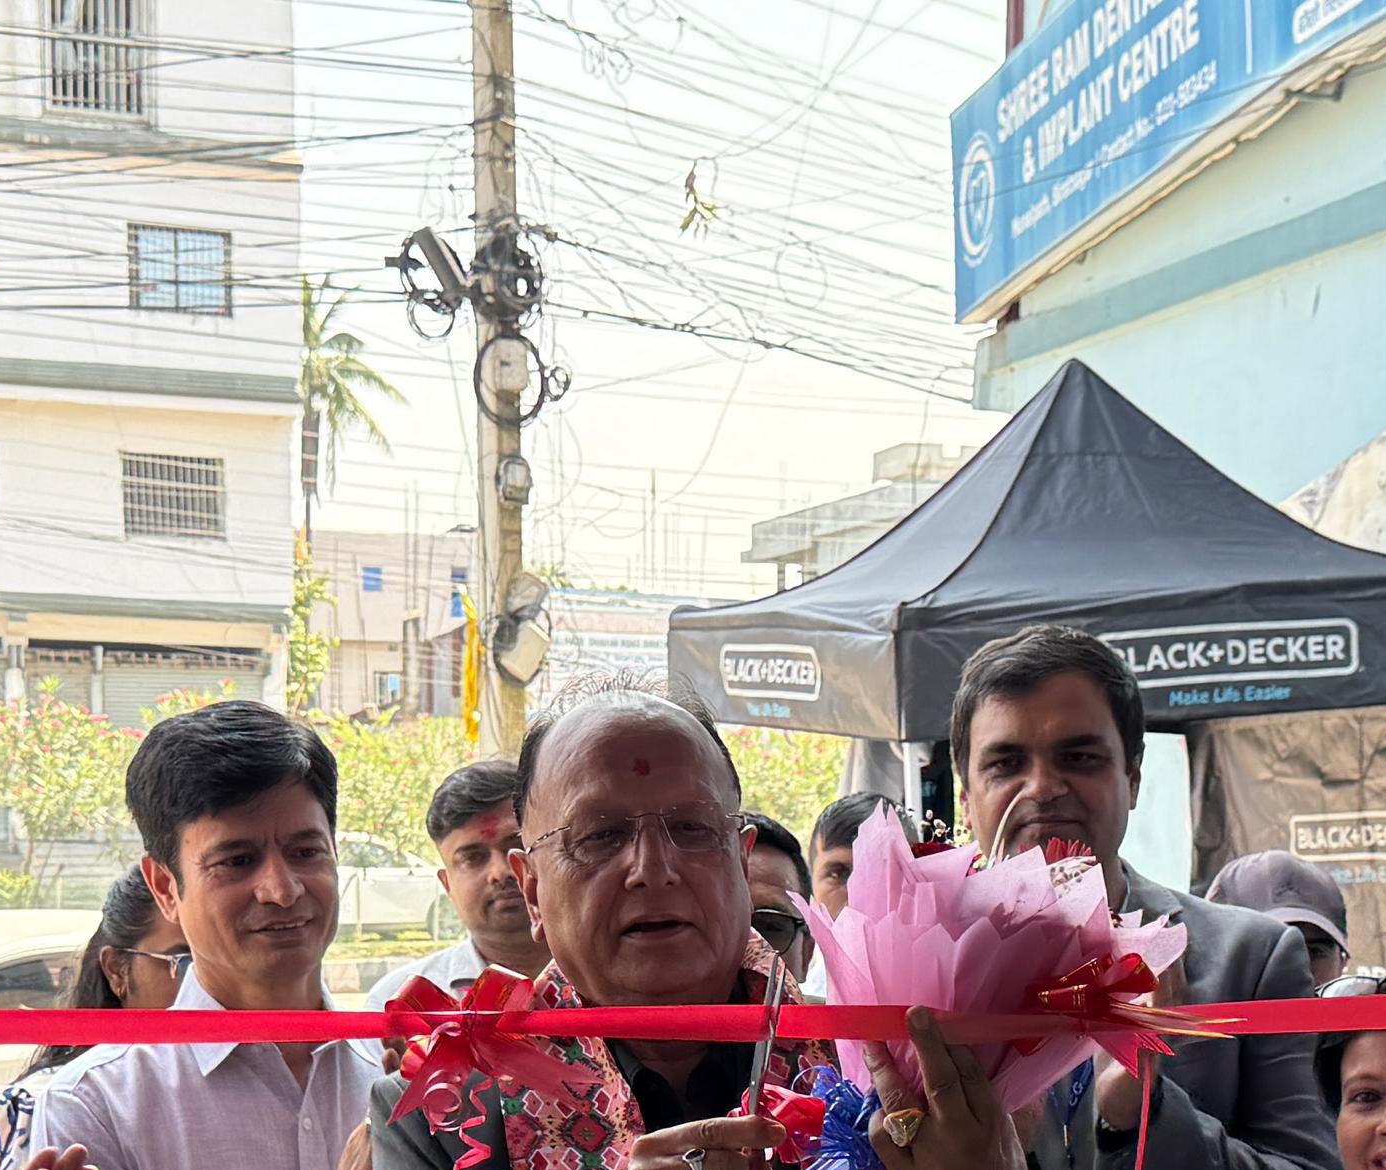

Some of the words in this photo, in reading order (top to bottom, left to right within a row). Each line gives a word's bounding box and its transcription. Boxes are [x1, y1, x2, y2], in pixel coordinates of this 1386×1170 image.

[996, 58, 1050, 144] SHREE
[1051, 20, 1091, 97] RAM
[1093, 0, 1163, 59] DEN
[1021, 135, 1035, 184] &
[1038, 63, 1114, 171] IMPLANT
[1117, 0, 1201, 103] CENTRE
[724, 657, 816, 686] BLACK+DECKER
[1169, 688, 1210, 706] Make
[1213, 686, 1241, 704] Life
[1244, 684, 1293, 702] Easier
